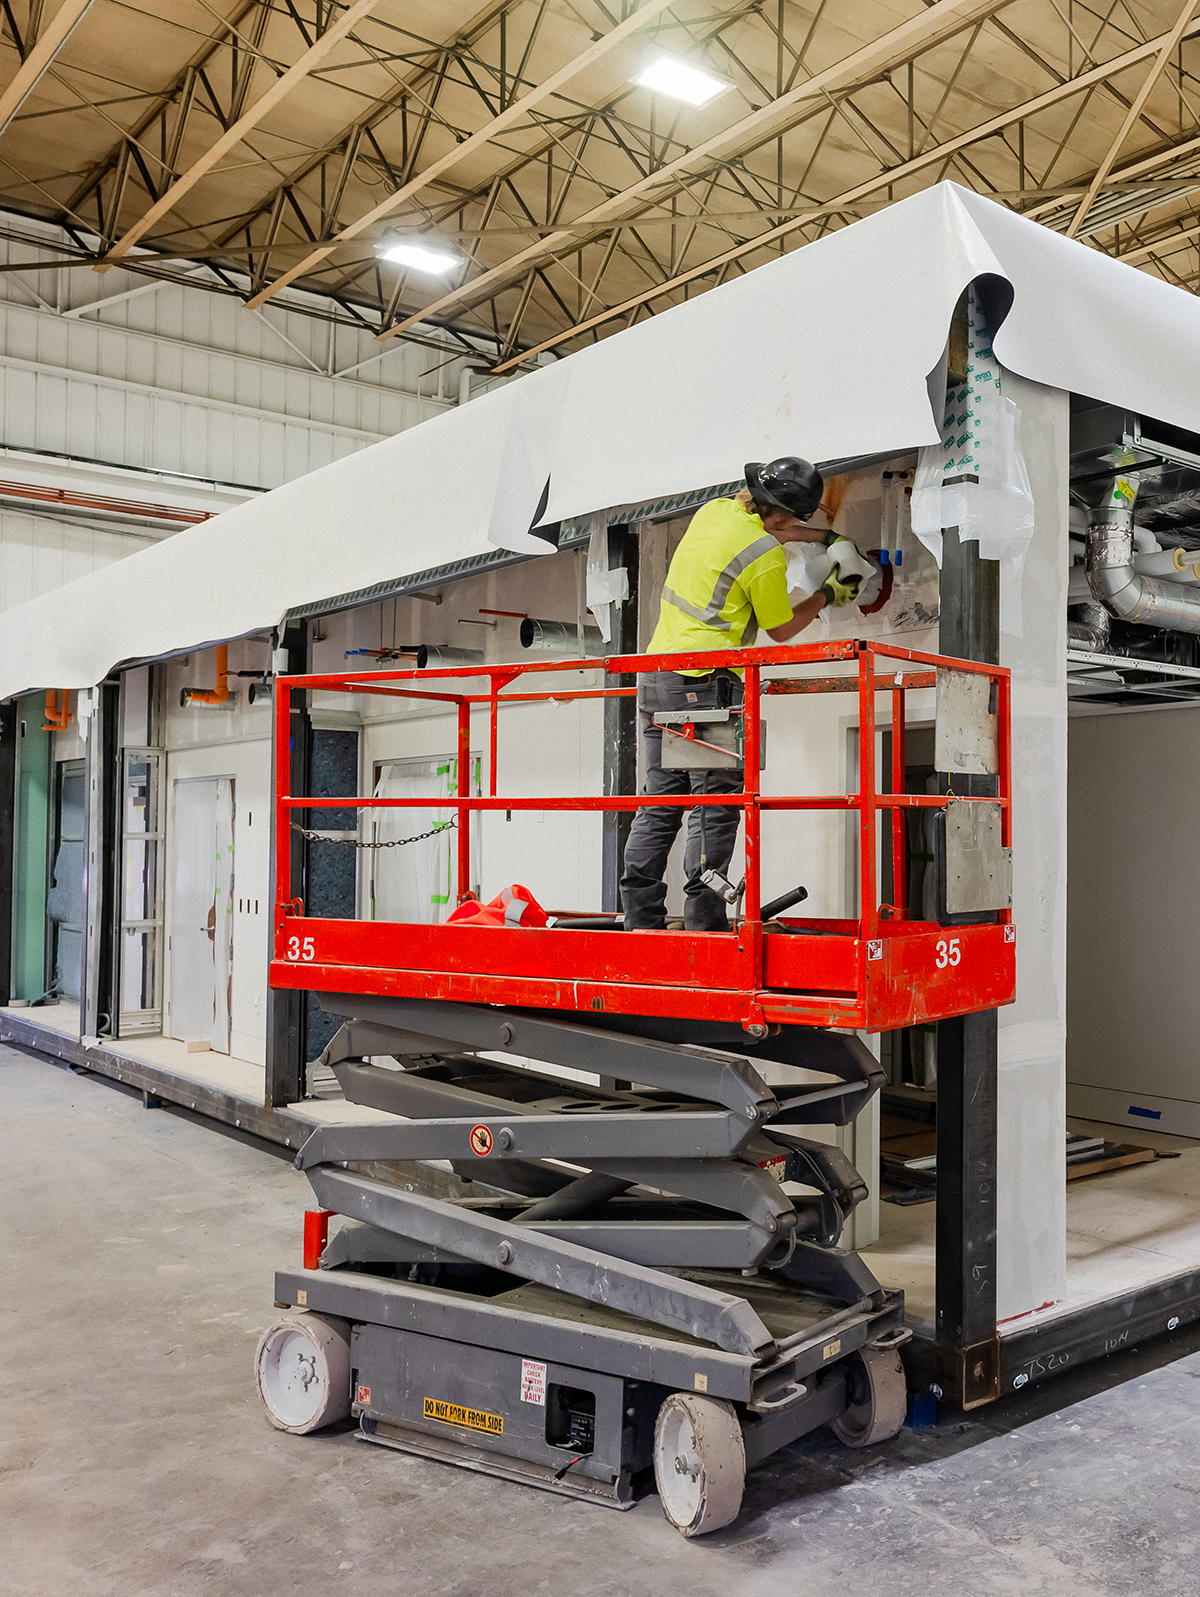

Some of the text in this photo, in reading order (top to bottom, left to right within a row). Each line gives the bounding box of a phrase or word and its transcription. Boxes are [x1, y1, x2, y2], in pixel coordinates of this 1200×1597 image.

[287, 936, 315, 961] 35
[935, 938, 961, 969] 35
[523, 1361, 546, 1372] IMPORTANT
[526, 1370, 541, 1378] CHECK
[524, 1391, 542, 1403] DAILY
[425, 1399, 502, 1432] DO NOT FORK FROM SIDE
